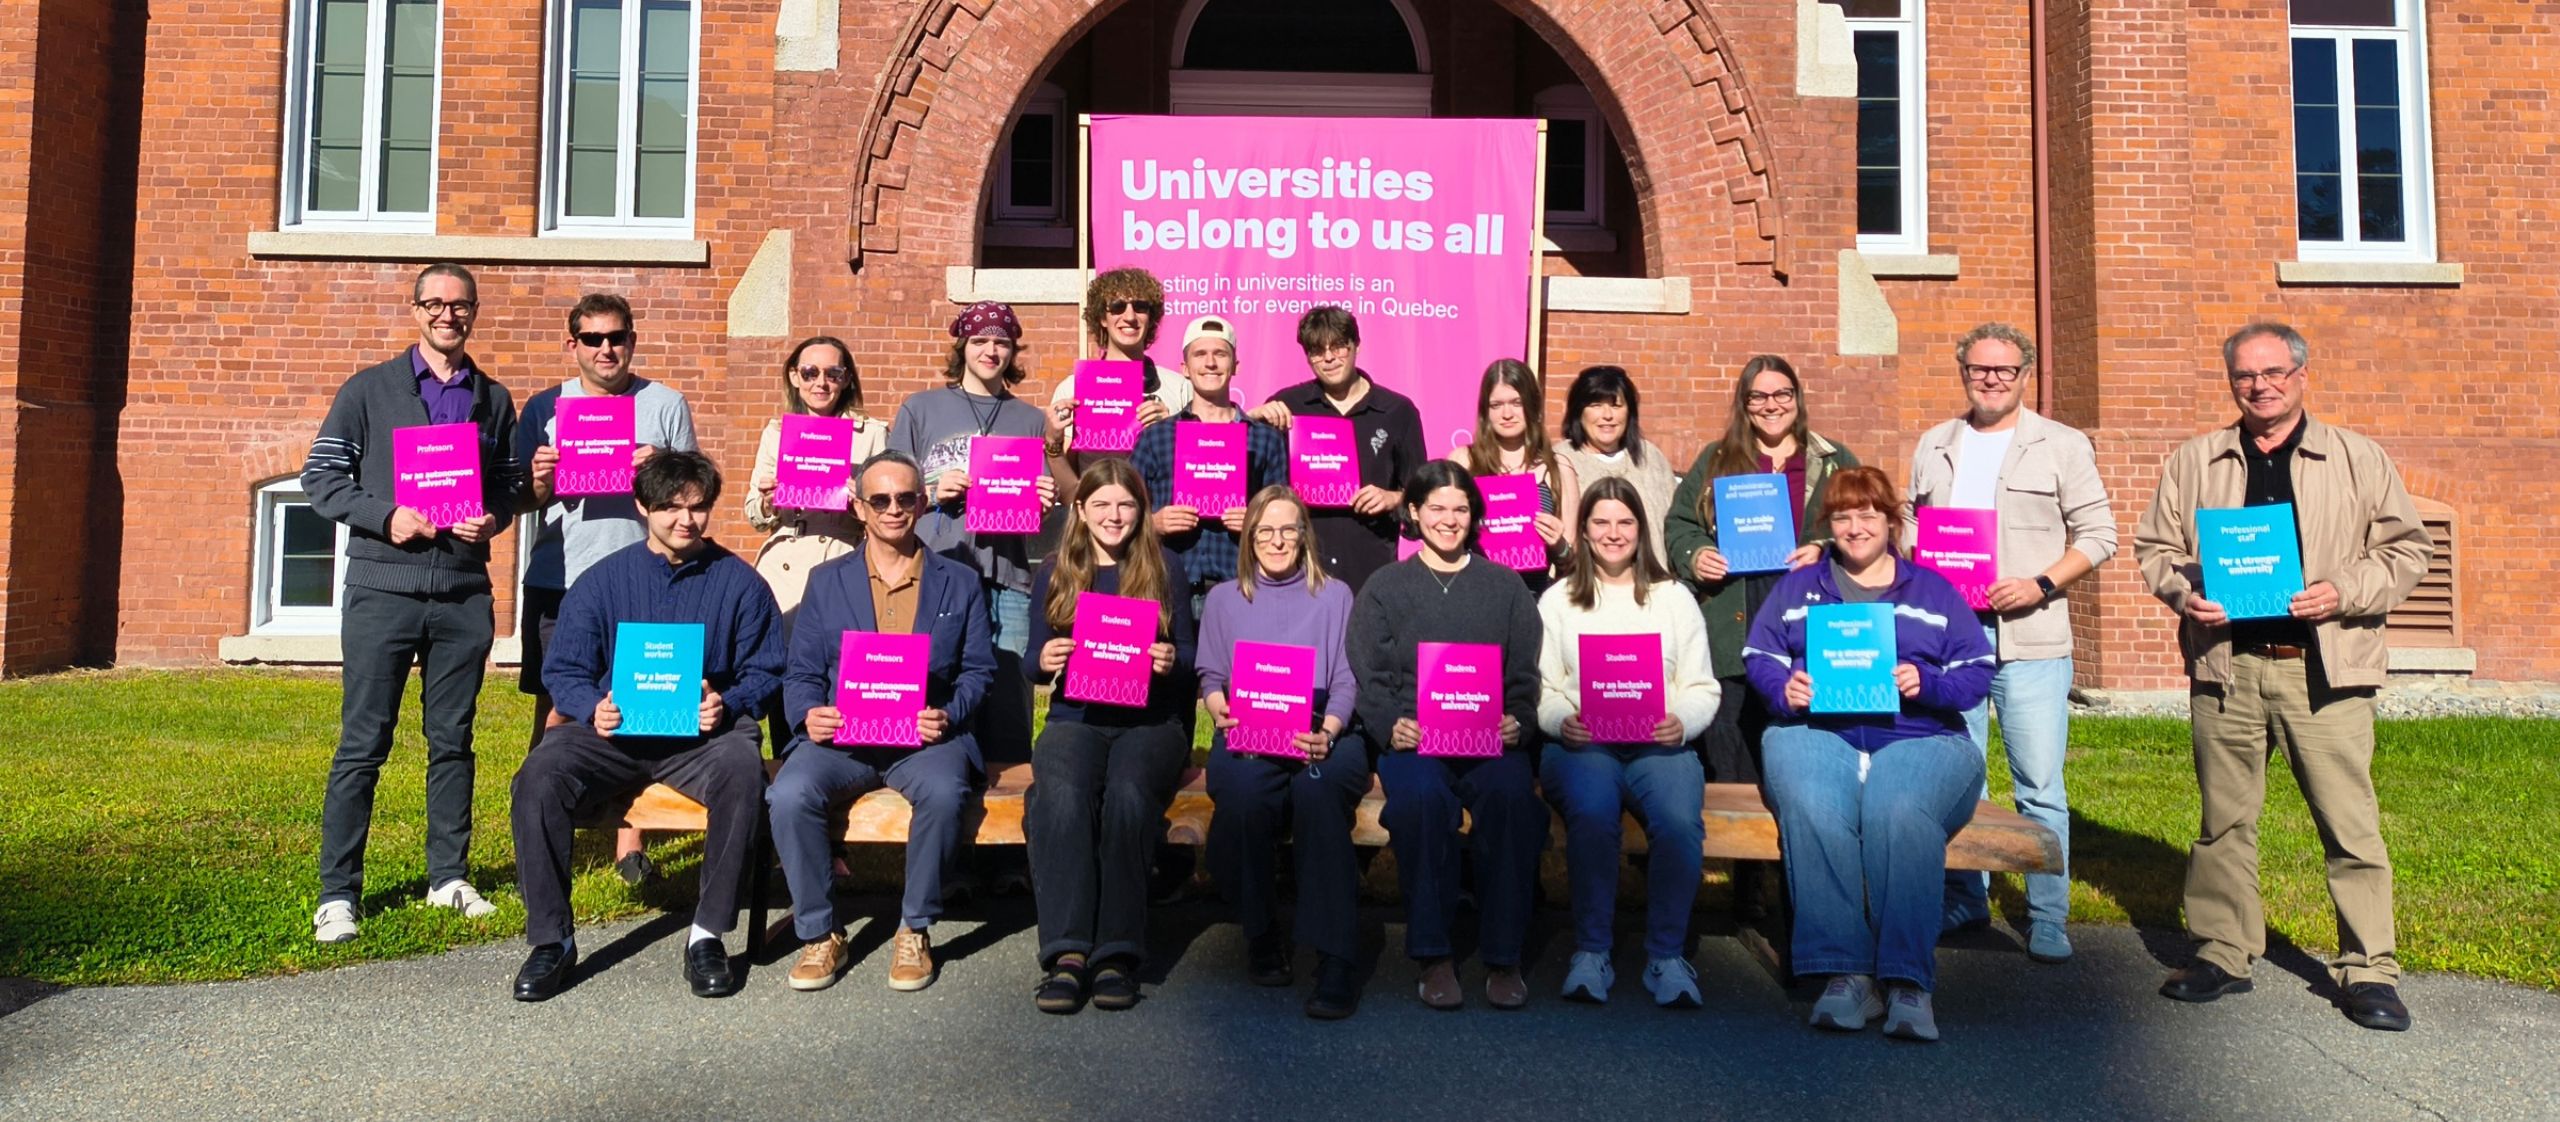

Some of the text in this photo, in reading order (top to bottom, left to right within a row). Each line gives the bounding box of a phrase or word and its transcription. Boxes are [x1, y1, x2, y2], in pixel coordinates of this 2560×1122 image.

[1121, 157, 1434, 200] Universities
[1122, 209, 1504, 258] belong to us all
[1163, 272, 1394, 295] sting in universities is an
[1164, 298, 1228, 314] stment
[1234, 296, 1259, 314] for
[1358, 296, 1375, 314] in
[1382, 298, 1458, 318] Quebec
[401, 472, 412, 482] For
[414, 472, 424, 480] an
[418, 478, 457, 488] university
[2221, 524, 2270, 535] Professional
[2238, 533, 2256, 542] staff
[2218, 557, 2234, 567] For
[2242, 555, 2280, 566] stronger
[2228, 565, 2274, 576] university
[644, 642, 674, 650] Student
[1084, 640, 1097, 650] For
[1098, 642, 1107, 650] an
[644, 650, 674, 659] workers
[1092, 650, 1130, 664] university
[634, 672, 647, 682] For
[654, 672, 682, 682] better
[636, 681, 678, 693] university
[845, 680, 920, 692] For an autonomous
[1592, 680, 1652, 690] For an inclusive
[862, 690, 902, 702] university
[1236, 688, 1249, 698] For
[1250, 690, 1259, 699] an
[1431, 692, 1444, 702] For
[1444, 693, 1454, 701] an
[1603, 689, 1642, 700] university
[1252, 699, 1290, 713] university
[1441, 700, 1480, 712] university
